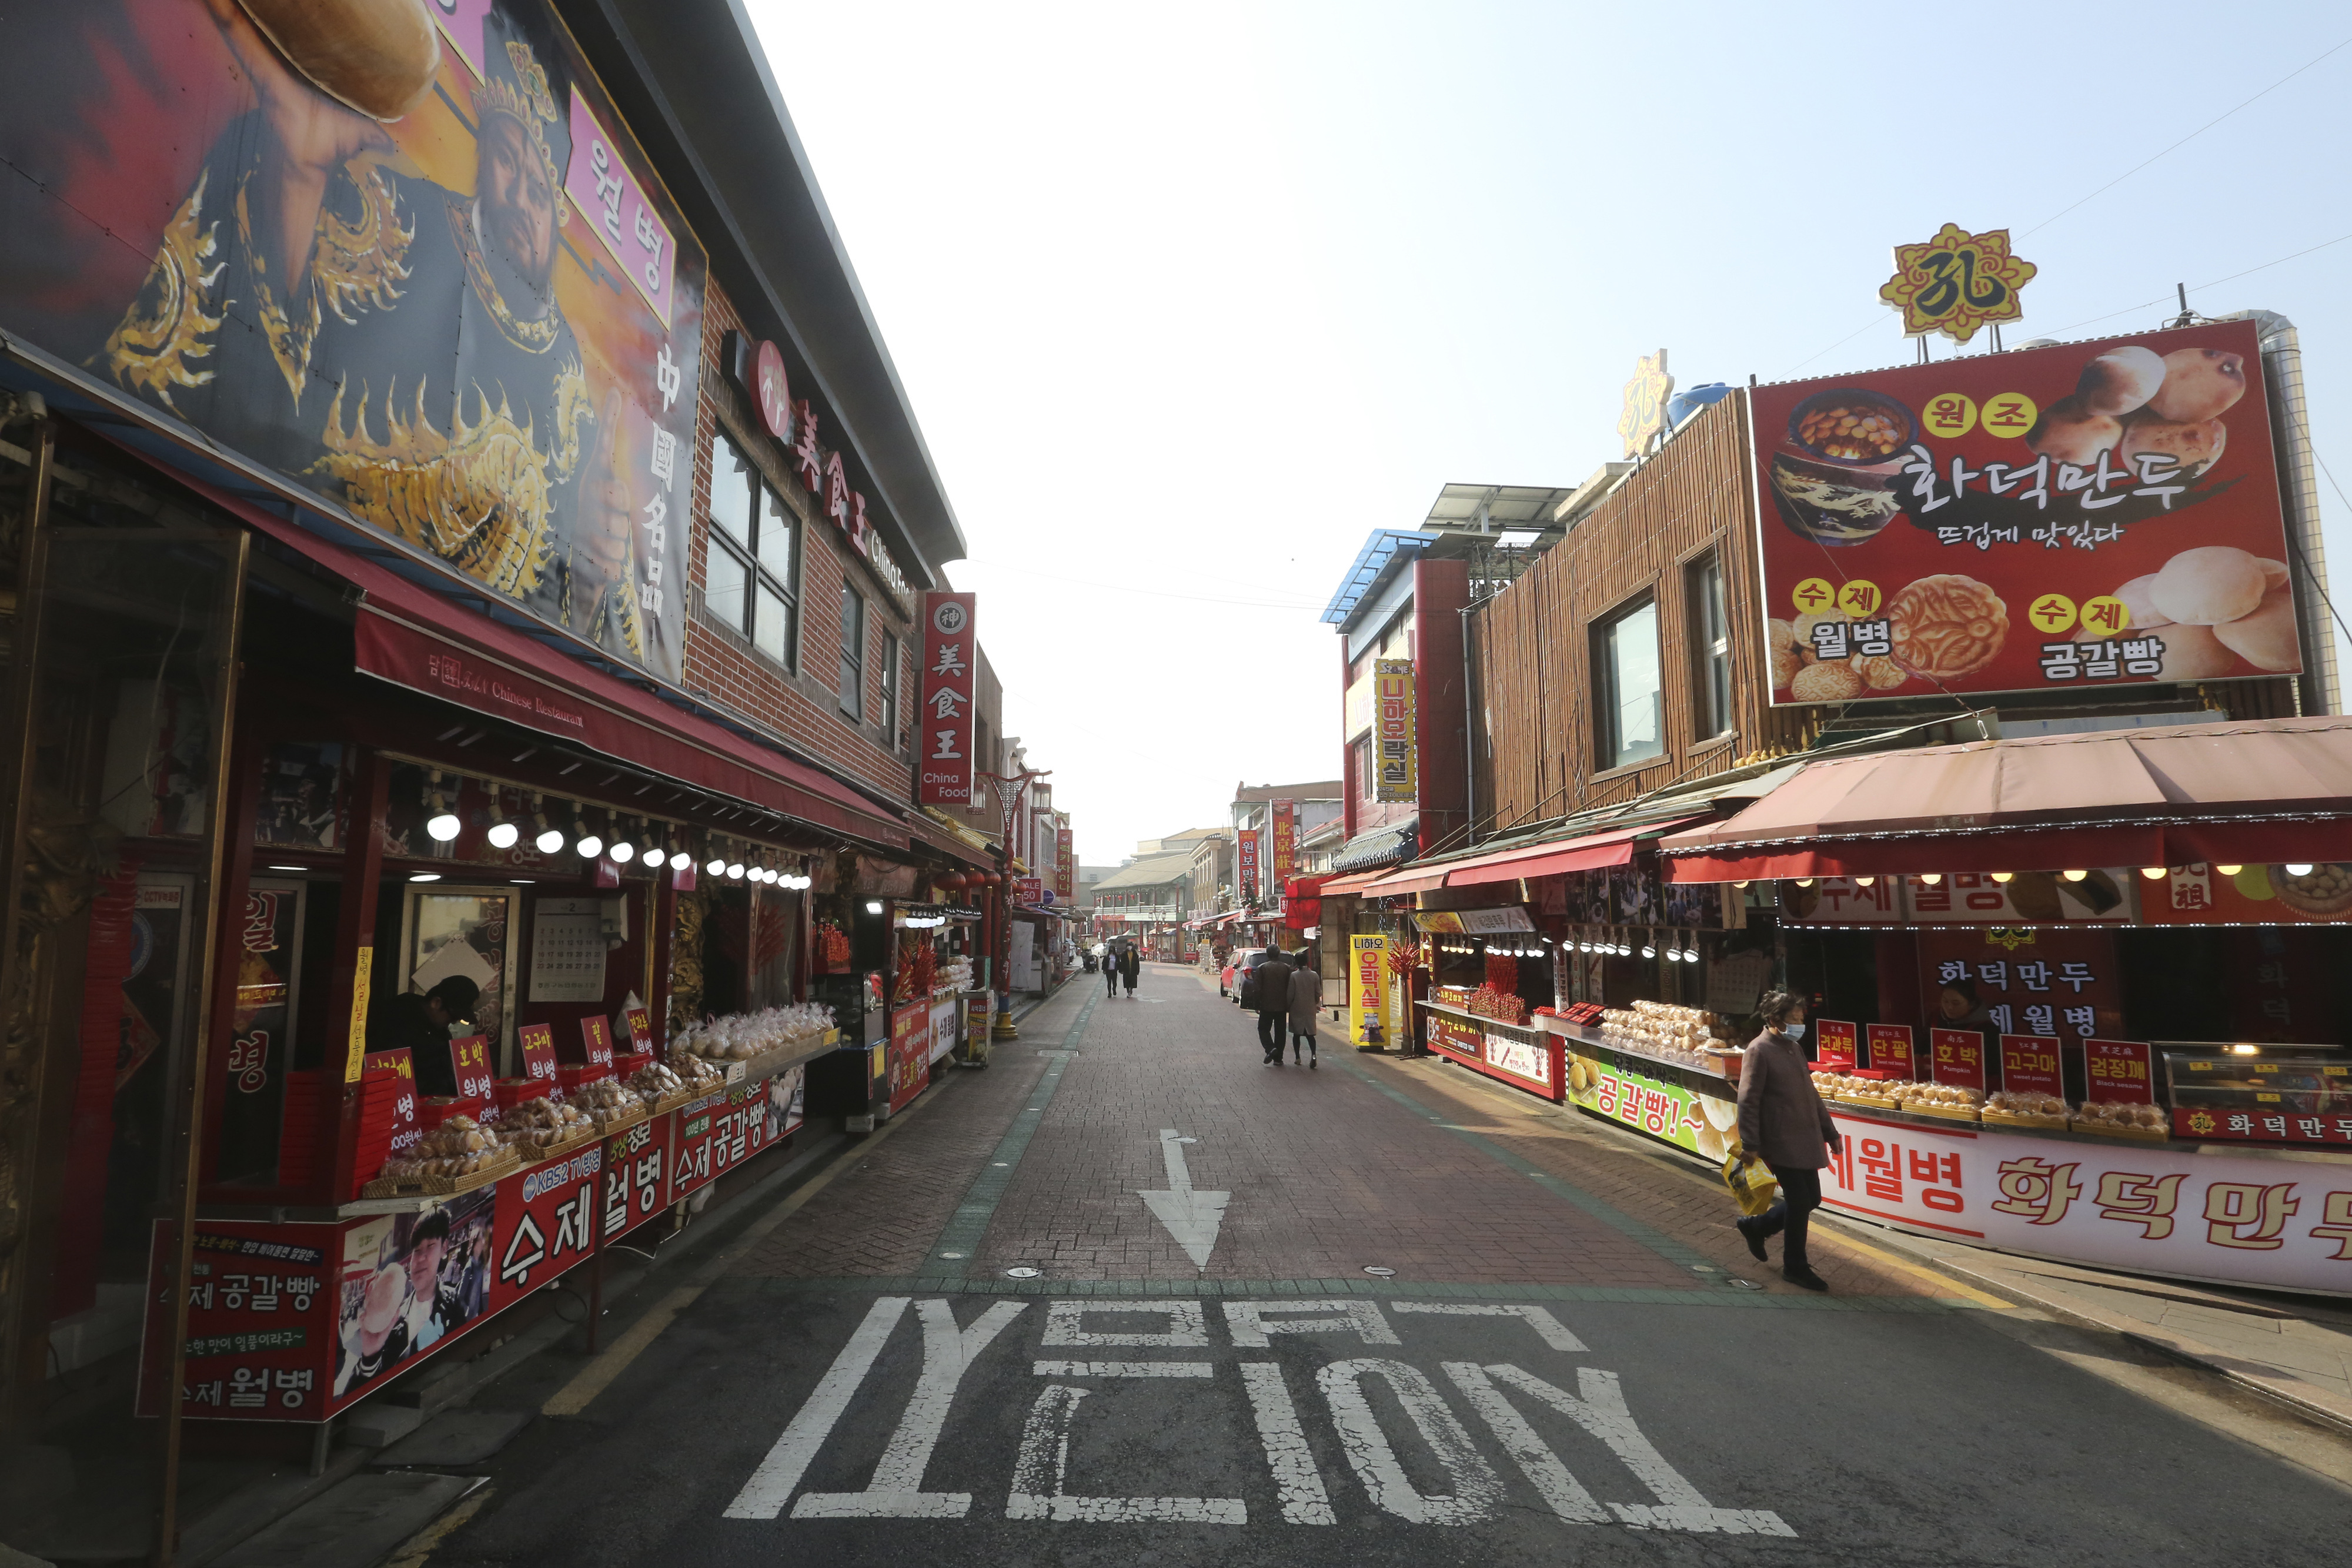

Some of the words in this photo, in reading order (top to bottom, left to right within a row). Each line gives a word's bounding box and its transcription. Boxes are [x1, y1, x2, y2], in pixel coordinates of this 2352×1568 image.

[589, 139, 664, 292] 월병
[1931, 399, 2027, 428] 원조
[642, 343, 680, 619] 中國名品
[797, 399, 868, 557] 美食王
[1905, 444, 2186, 513] 화덕만두
[1937, 523, 2019, 550] 뜨겁게
[2032, 521, 2124, 550] 맛있다
[871, 530, 896, 588] China
[1799, 584, 1873, 611] 수제
[2036, 599, 2120, 630] 수제
[1813, 621, 1892, 659] 월병
[2042, 641, 2164, 678] 공갈빵
[492, 681, 532, 710] Chinese
[536, 697, 584, 728] Restaurant
[928, 644, 967, 759] 美食王
[923, 773, 959, 784] China
[939, 787, 968, 797] Food
[1060, 845, 1071, 892] 럭키차이나
[1242, 841, 1255, 890] 원보만
[569, 903, 576, 912] 2
[1024, 891, 1035, 900] 50
[1354, 938, 1384, 949] 니하오
[1360, 951, 1381, 1008] 오락실
[1939, 961, 2096, 992] 화덕만두
[524, 1029, 550, 1050] 고구마
[592, 1021, 602, 1045] 팥
[1820, 1034, 1853, 1054] 견과류
[1947, 1035, 1965, 1043] 南瓜
[460, 1041, 483, 1066] 호박
[1872, 1039, 1908, 1059] 단팥
[1937, 1044, 1978, 1066] 호박
[2006, 1052, 2056, 1073] 고구마
[2100, 1046, 2134, 1056] 黑芝麻
[1943, 1065, 1970, 1074] Pumpkin
[2090, 1057, 2146, 1080] 검정깨
[2096, 1079, 2114, 1088] Black
[2117, 1082, 2143, 1090] sesame
[686, 1121, 699, 1136] 100년
[700, 1116, 710, 1130] 전통
[714, 1099, 766, 1167] 공갈빵
[676, 1136, 711, 1191] 수제
[537, 1165, 569, 1193] KBS2
[606, 1149, 662, 1235] 월병
[502, 1183, 592, 1285] 수제
[219, 1275, 322, 1312] 공갈빵
[208, 1338, 231, 1354] 맛이
[235, 1331, 303, 1352] 일품이라구~
[229, 1368, 313, 1409] 월병
[722, 1297, 1798, 1537] 진입금지
